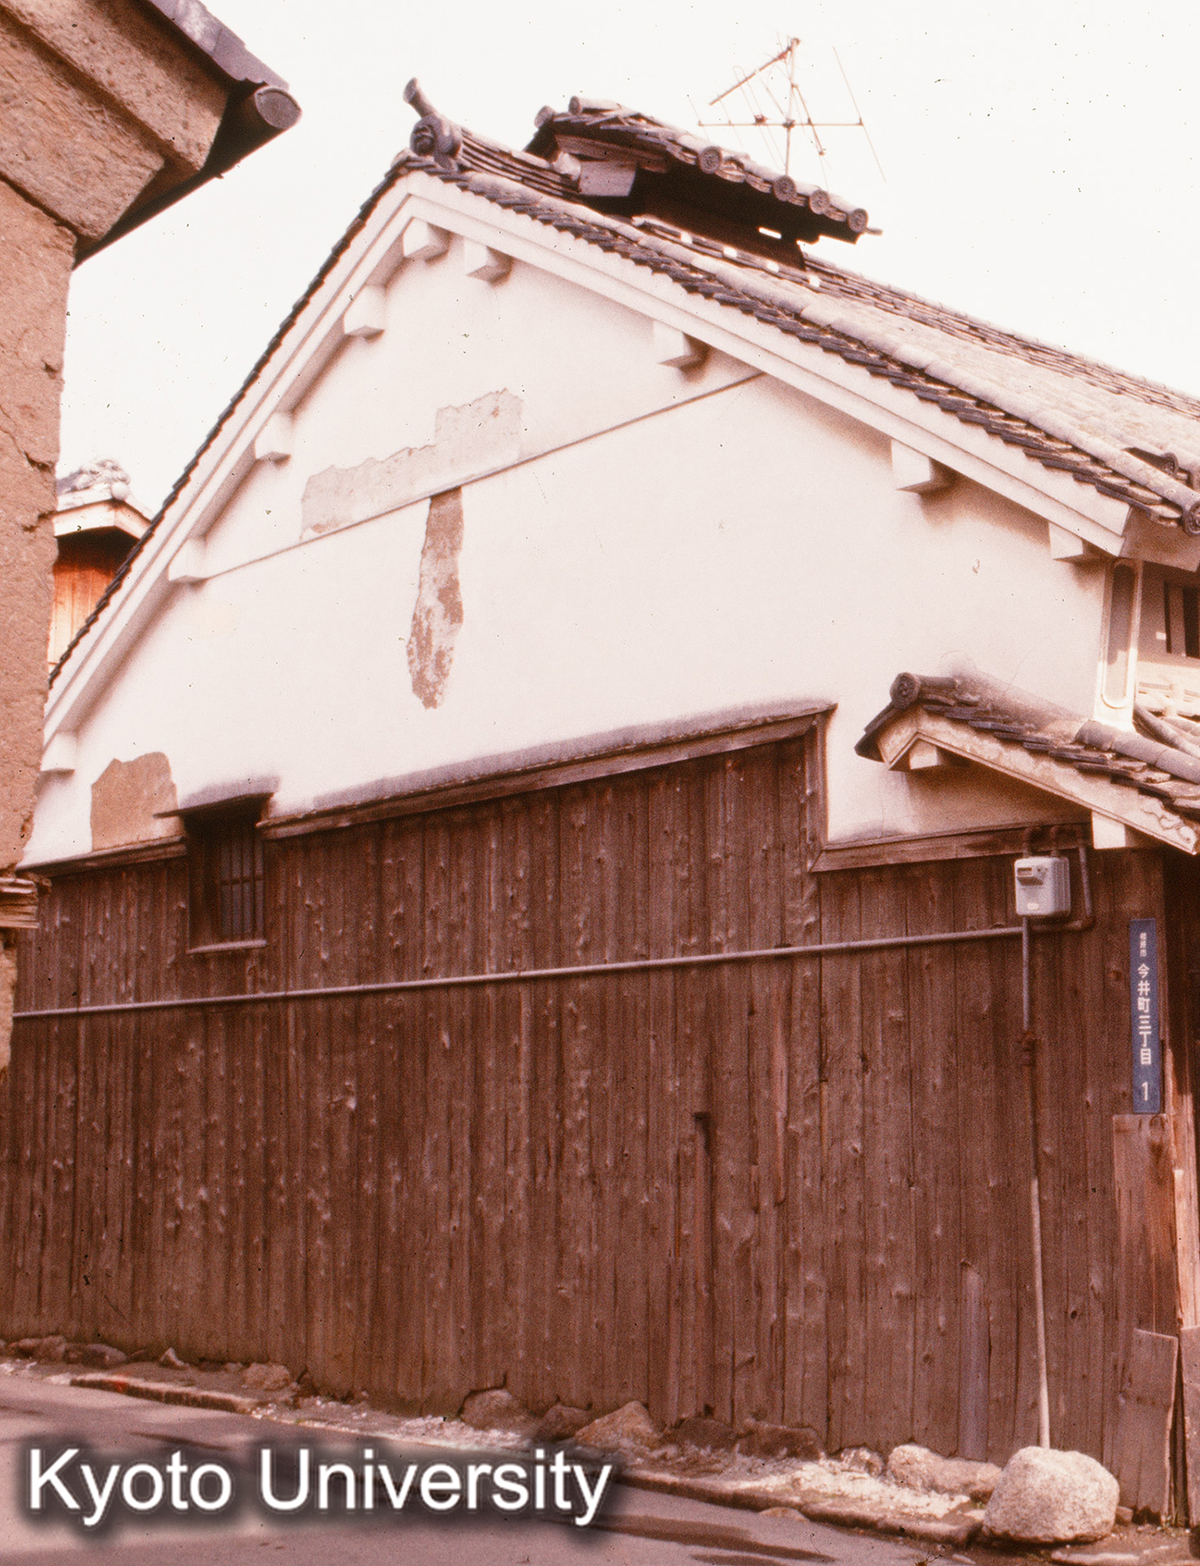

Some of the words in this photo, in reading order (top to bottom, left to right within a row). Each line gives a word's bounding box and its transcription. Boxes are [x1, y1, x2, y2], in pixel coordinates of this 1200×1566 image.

[1137, 962, 1152, 1066] 今井町三丁目
[1141, 1081, 1149, 1102] 1
